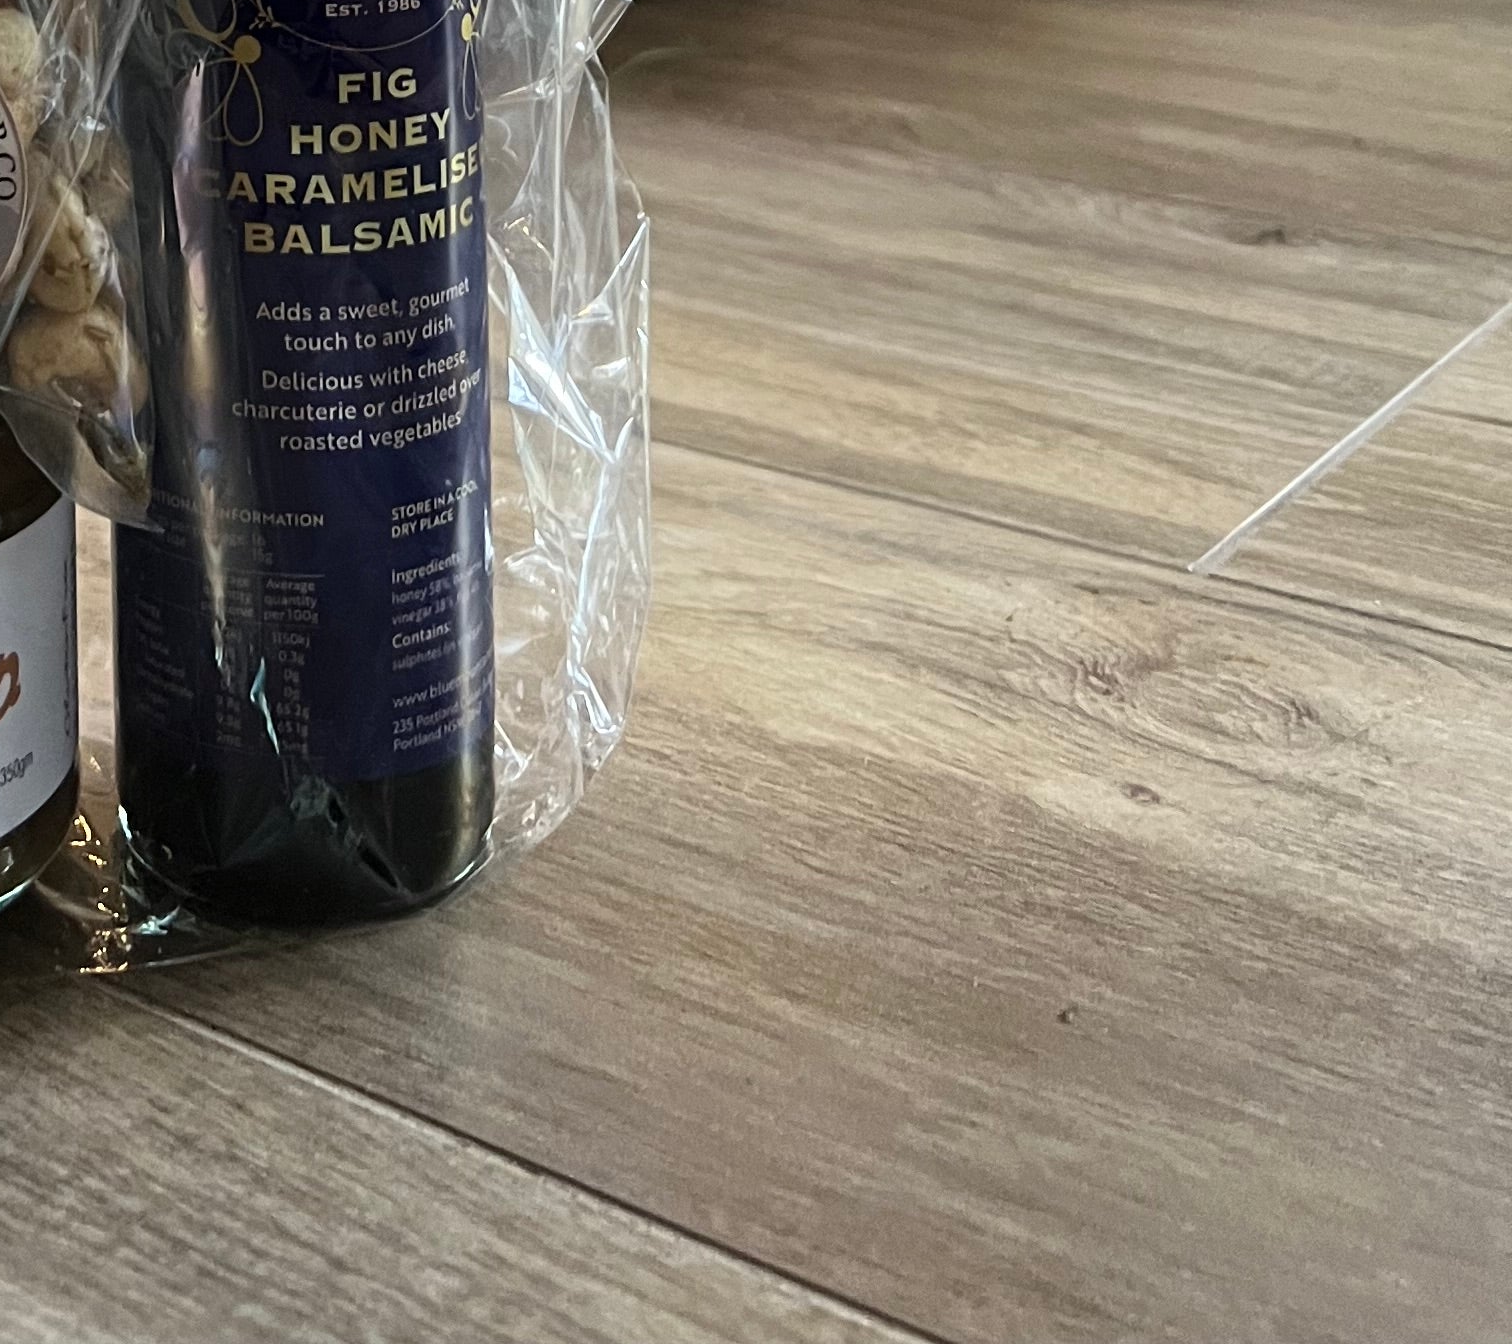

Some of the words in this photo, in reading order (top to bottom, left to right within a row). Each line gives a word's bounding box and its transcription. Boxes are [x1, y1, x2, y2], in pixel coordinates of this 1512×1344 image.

[338, 67, 418, 105] FIG
[289, 108, 451, 156] HONEY
[197, 141, 480, 206] CARAMELISE
[244, 196, 475, 256] BALSAMIC
[256, 301, 313, 322] Adds
[319, 305, 332, 322] a
[338, 297, 404, 322] sweet,
[408, 277, 471, 317] gourmet
[284, 332, 348, 352] touch
[355, 331, 377, 350] to
[382, 327, 418, 349] any
[231, 399, 357, 422] charcuterie
[363, 400, 386, 419] or
[391, 377, 458, 416] drizzled
[459, 367, 482, 395] over
[262, 369, 364, 392] Delicious
[369, 364, 414, 387] with
[280, 429, 363, 451] roasted
[369, 410, 462, 450] vegetables
[391, 498, 433, 521] STORE
[433, 494, 446, 510] IN
[447, 492, 456, 505] A
[391, 521, 418, 539] DRY
[419, 507, 455, 532] PLACE
[265, 578, 316, 593] Average
[391, 587, 428, 605] honey
[393, 726, 442, 753] Portland
